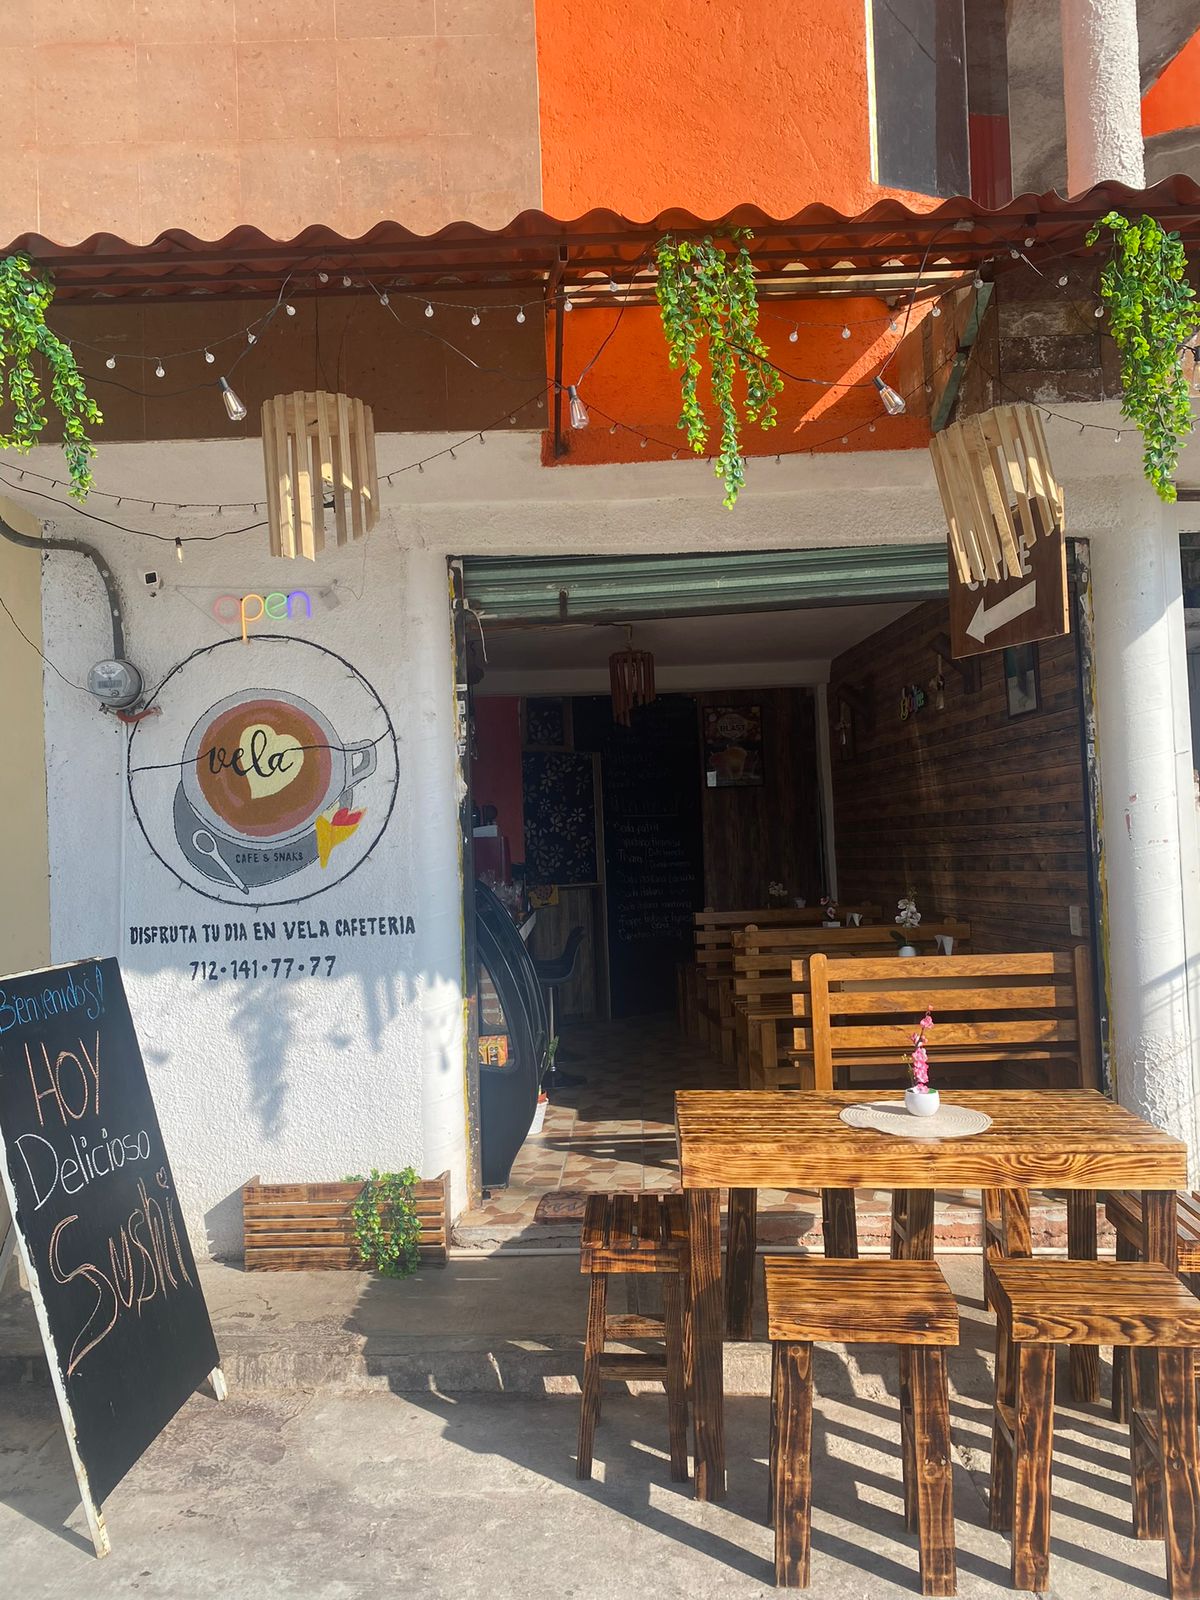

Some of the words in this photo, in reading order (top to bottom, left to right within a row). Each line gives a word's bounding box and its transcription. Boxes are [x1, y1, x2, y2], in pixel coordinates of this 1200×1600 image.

[213, 590, 312, 641] open
[209, 729, 294, 778] vela
[235, 853, 260, 864] CAFE
[273, 851, 304, 862] SNAKS
[130, 925, 197, 945] DISFRUTA
[202, 923, 220, 943] TU
[225, 922, 248, 942] DIA
[254, 921, 276, 941] EN
[283, 919, 330, 940] VELA
[335, 916, 416, 937] CAFETERIA
[24, 1031, 100, 1127] HOY
[14, 1127, 150, 1211] Delicioso
[48, 1172, 194, 1378] Sushi
